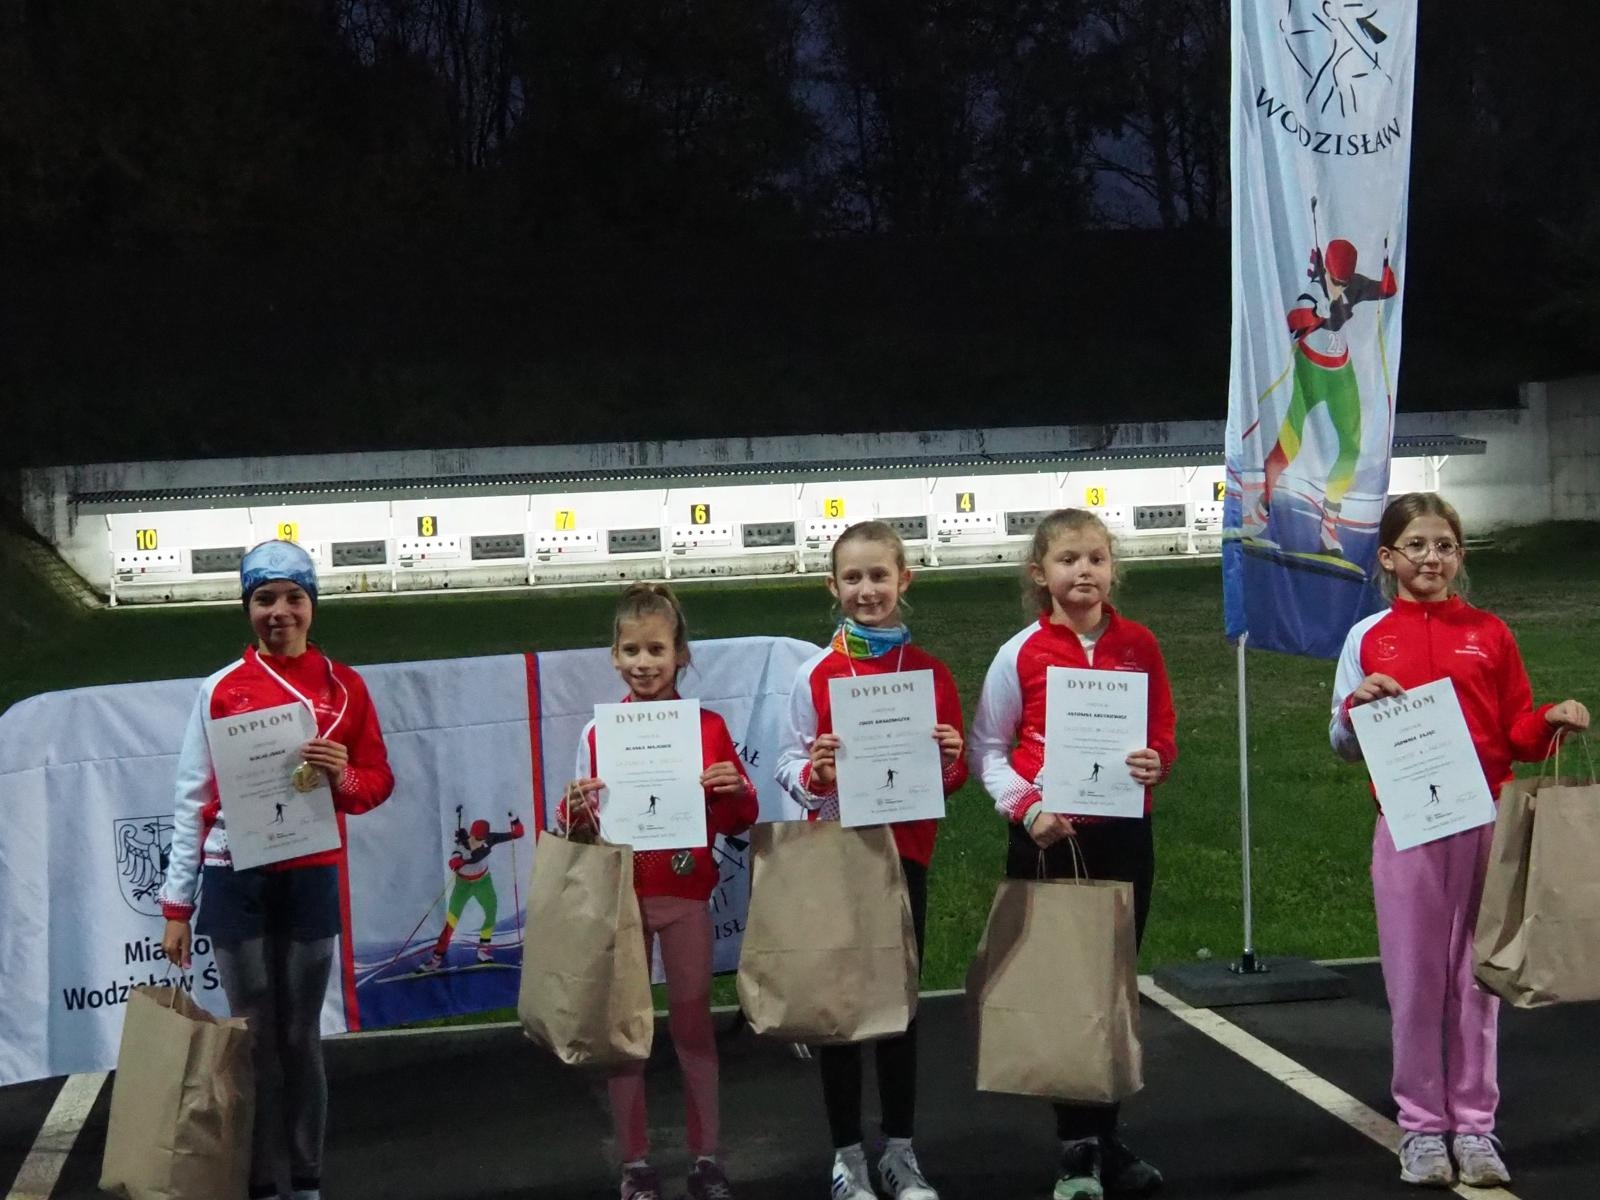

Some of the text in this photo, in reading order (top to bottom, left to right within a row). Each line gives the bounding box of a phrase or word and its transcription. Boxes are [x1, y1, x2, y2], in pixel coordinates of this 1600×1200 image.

[1256, 86, 1401, 156] WODZISŁAW
[1090, 487, 1100, 506] 3
[1217, 481, 1227, 502] 2
[830, 499, 839, 518] 5
[959, 492, 972, 513] 4
[559, 510, 570, 530] 7
[694, 504, 707, 525] 6
[283, 523, 293, 541] 9
[422, 516, 434, 537] 8
[138, 529, 157, 550] 10
[850, 682, 915, 699] DYPLOM
[1066, 679, 1129, 693] DYPLOM
[615, 710, 680, 725] DYPLOM
[1372, 694, 1436, 724] DYPLOM
[227, 712, 294, 737] DYPLOM
[124, 936, 211, 965] Miao
